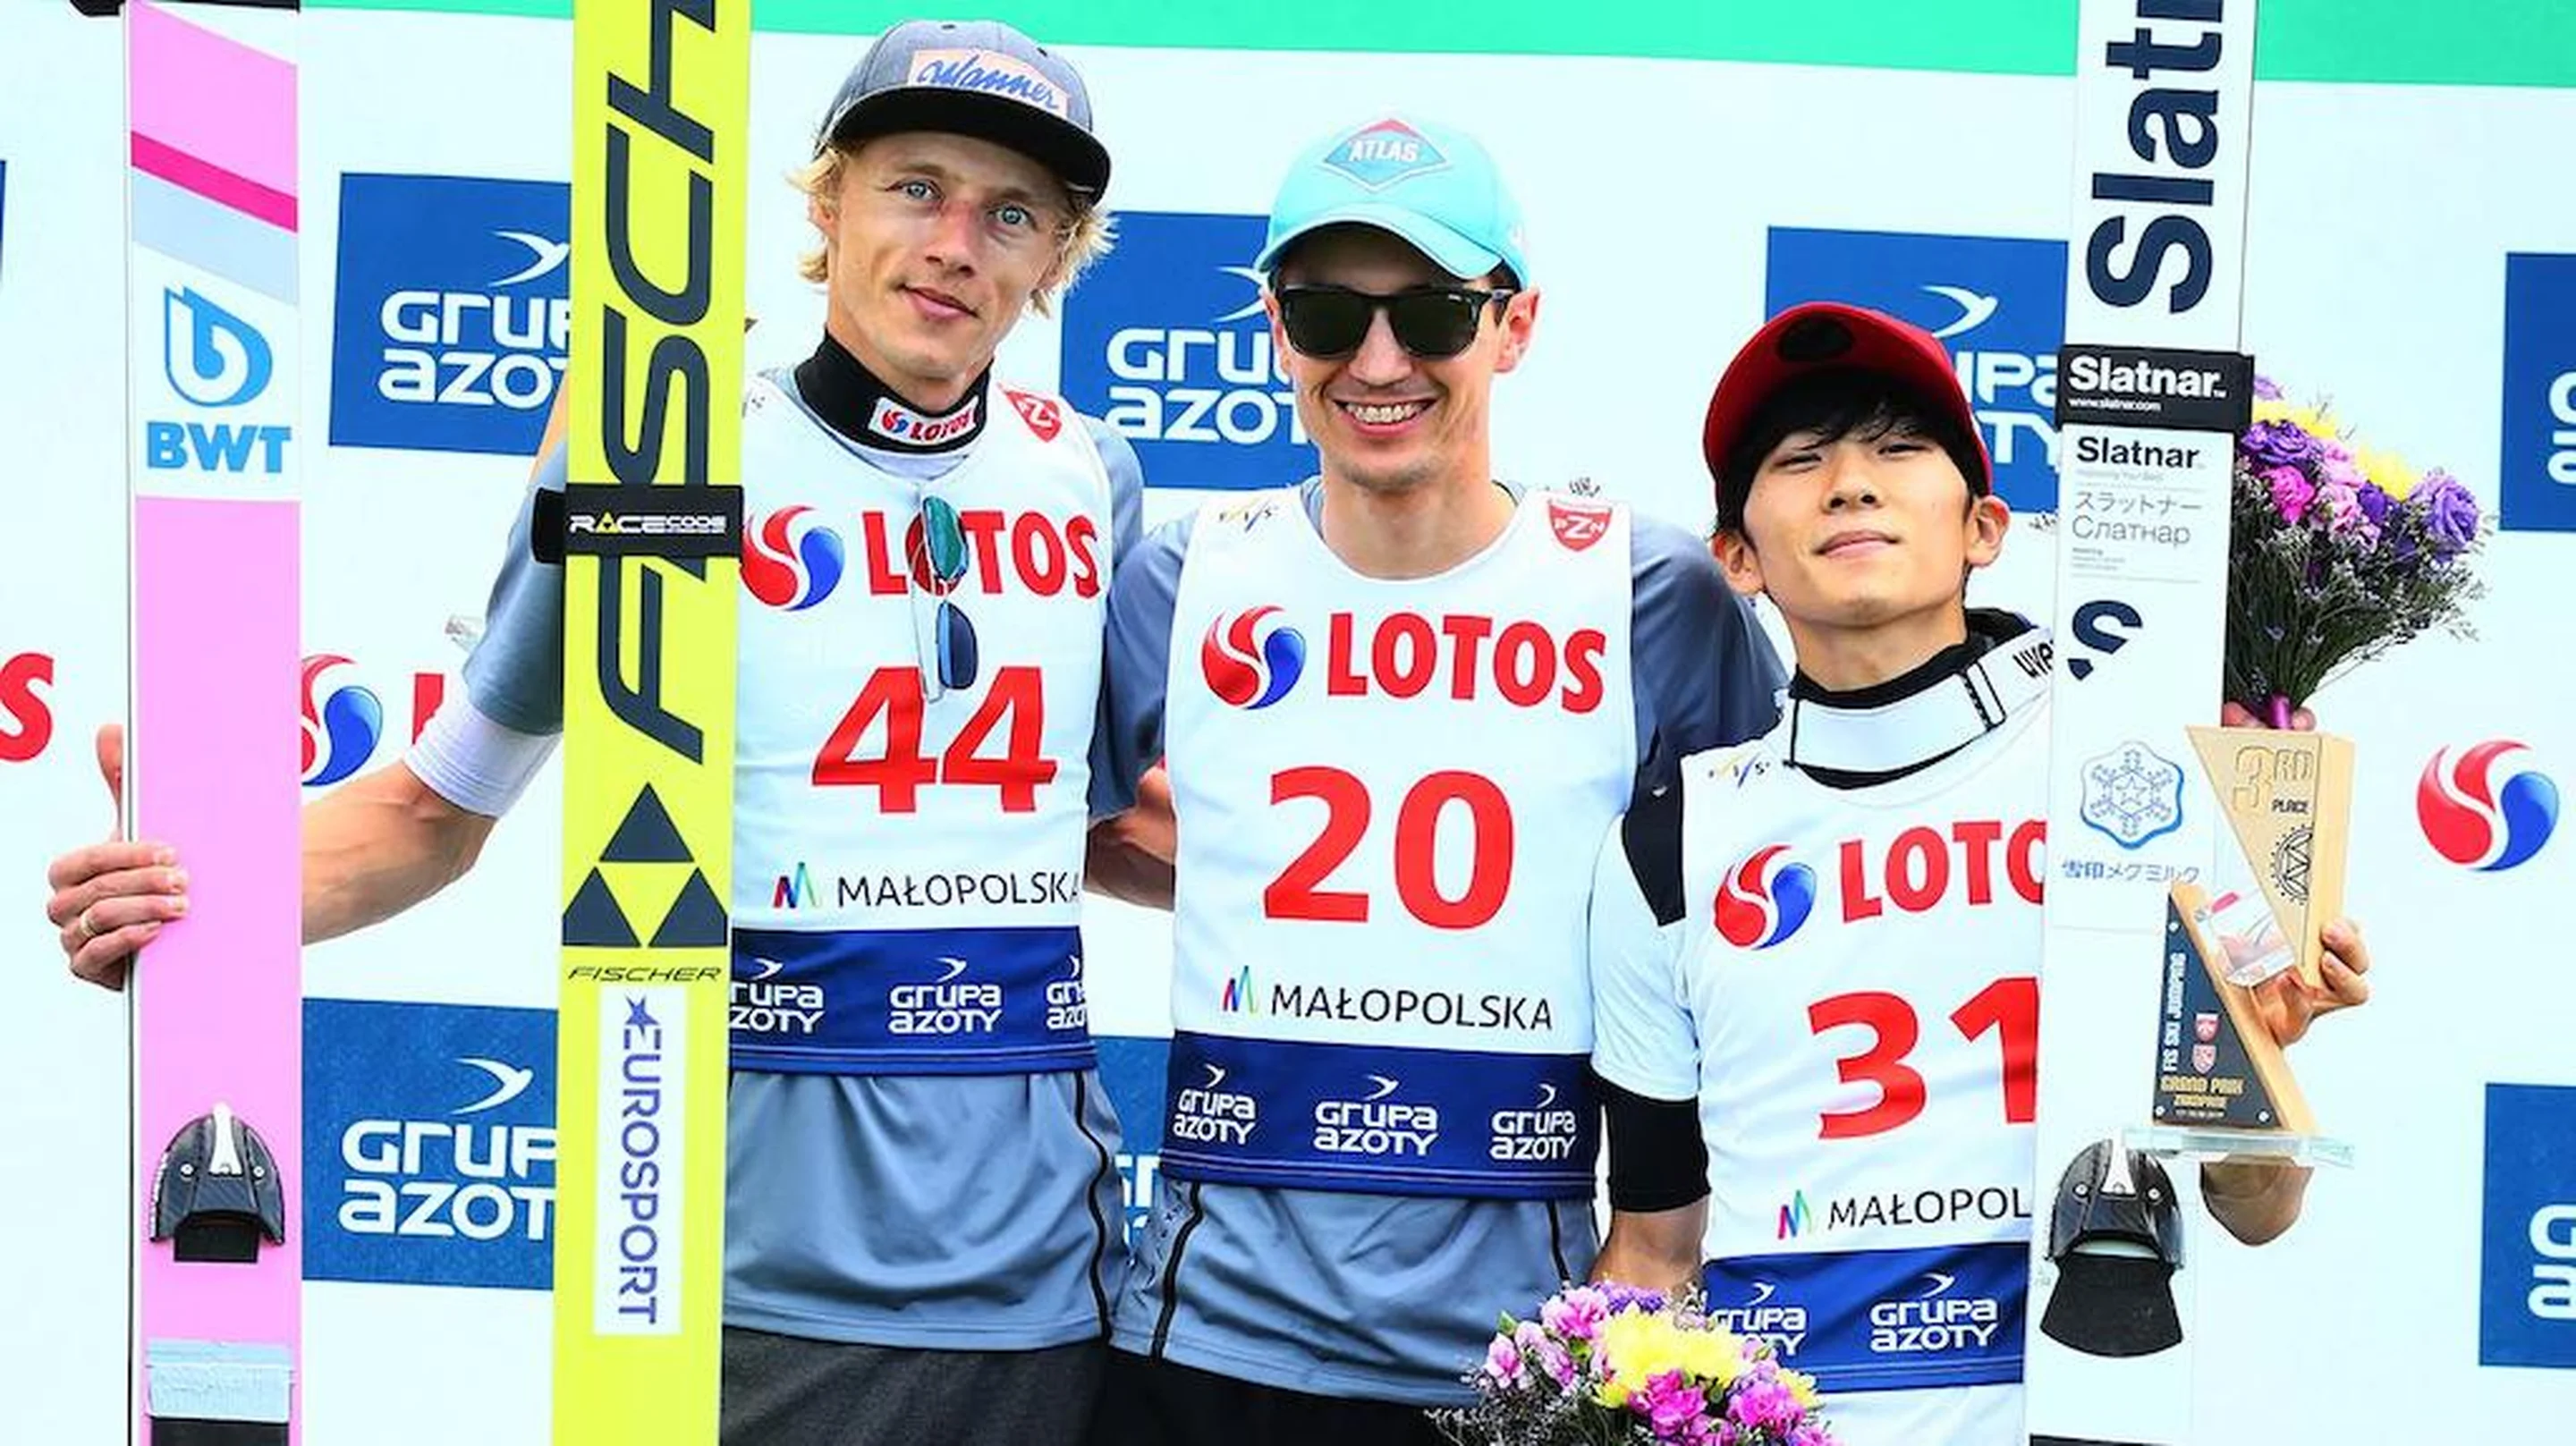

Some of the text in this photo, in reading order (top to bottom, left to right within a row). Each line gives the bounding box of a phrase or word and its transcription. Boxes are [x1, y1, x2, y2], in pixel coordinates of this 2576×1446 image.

[1349, 140, 1418, 161] ATLAS
[2068, 397, 2162, 412] www.slatnar.com
[910, 406, 974, 442] LOTOS
[147, 421, 292, 474] BWT
[2076, 435, 2200, 469] Slatnar
[2075, 490, 2203, 515] スラットナー
[2072, 514, 2191, 548] Слатнар
[1327, 611, 1607, 715] LOTOS
[812, 665, 1058, 814] 44
[2271, 798, 2309, 815] PLACE
[1264, 765, 1516, 931] 20
[2061, 859, 2200, 883] 雪印メグミルク
[567, 967, 722, 983] FISCHER
[1270, 983, 1554, 1031] MAŁOPOLSKA
[1807, 977, 2038, 1140] 31
[618, 1027, 662, 1324] EUROSPORT
[1827, 1187, 2032, 1231] MAŁOPOL
